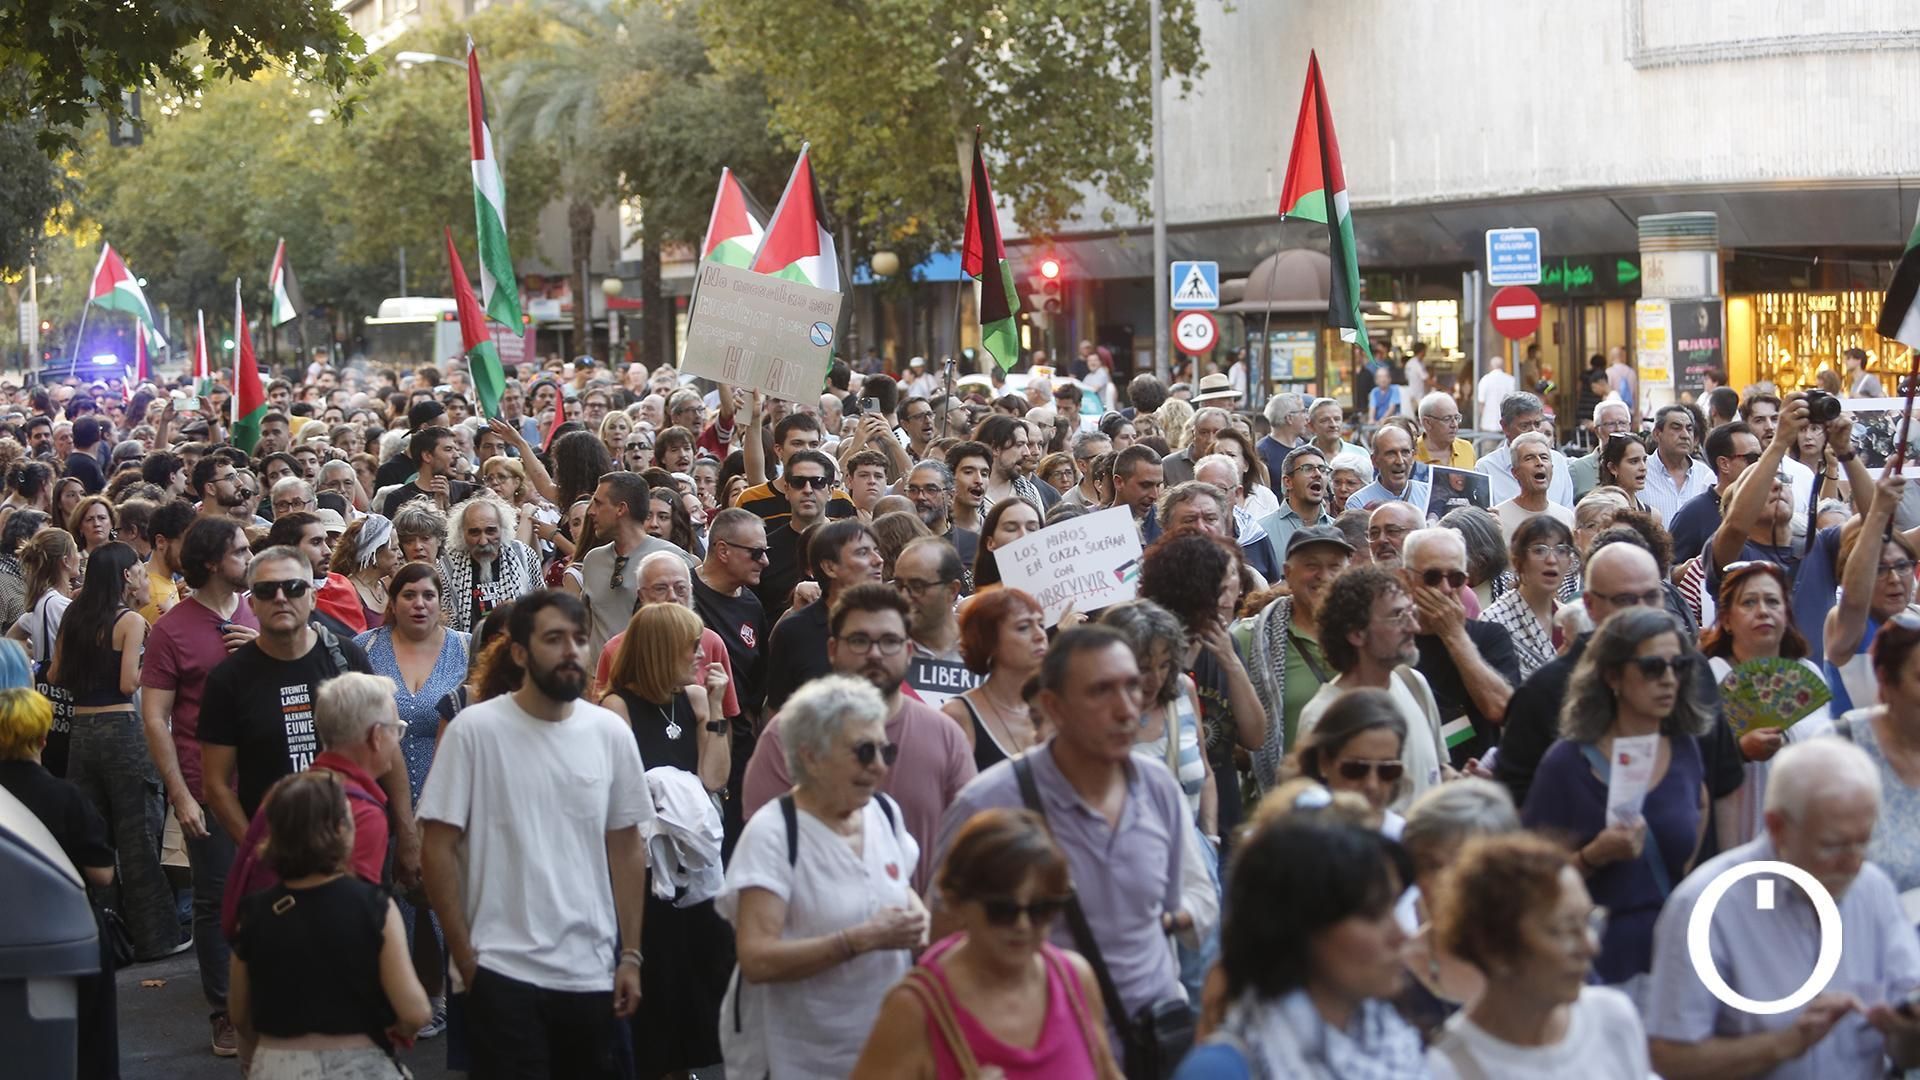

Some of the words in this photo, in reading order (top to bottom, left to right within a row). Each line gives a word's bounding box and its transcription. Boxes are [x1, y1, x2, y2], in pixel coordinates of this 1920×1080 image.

[704, 266, 727, 287] No
[1183, 323, 1208, 338] 20
[1014, 543, 1039, 562] LOS
[1045, 527, 1089, 549] NIÑOS
[1026, 559, 1043, 577] EN
[1048, 545, 1081, 564] GAZA
[1086, 533, 1126, 555] SUEÑAN
[1053, 564, 1075, 579] CON
[281, 694, 310, 705] LASKER
[285, 720, 315, 734] EUWE
[289, 742, 317, 753] SMYSLOV
